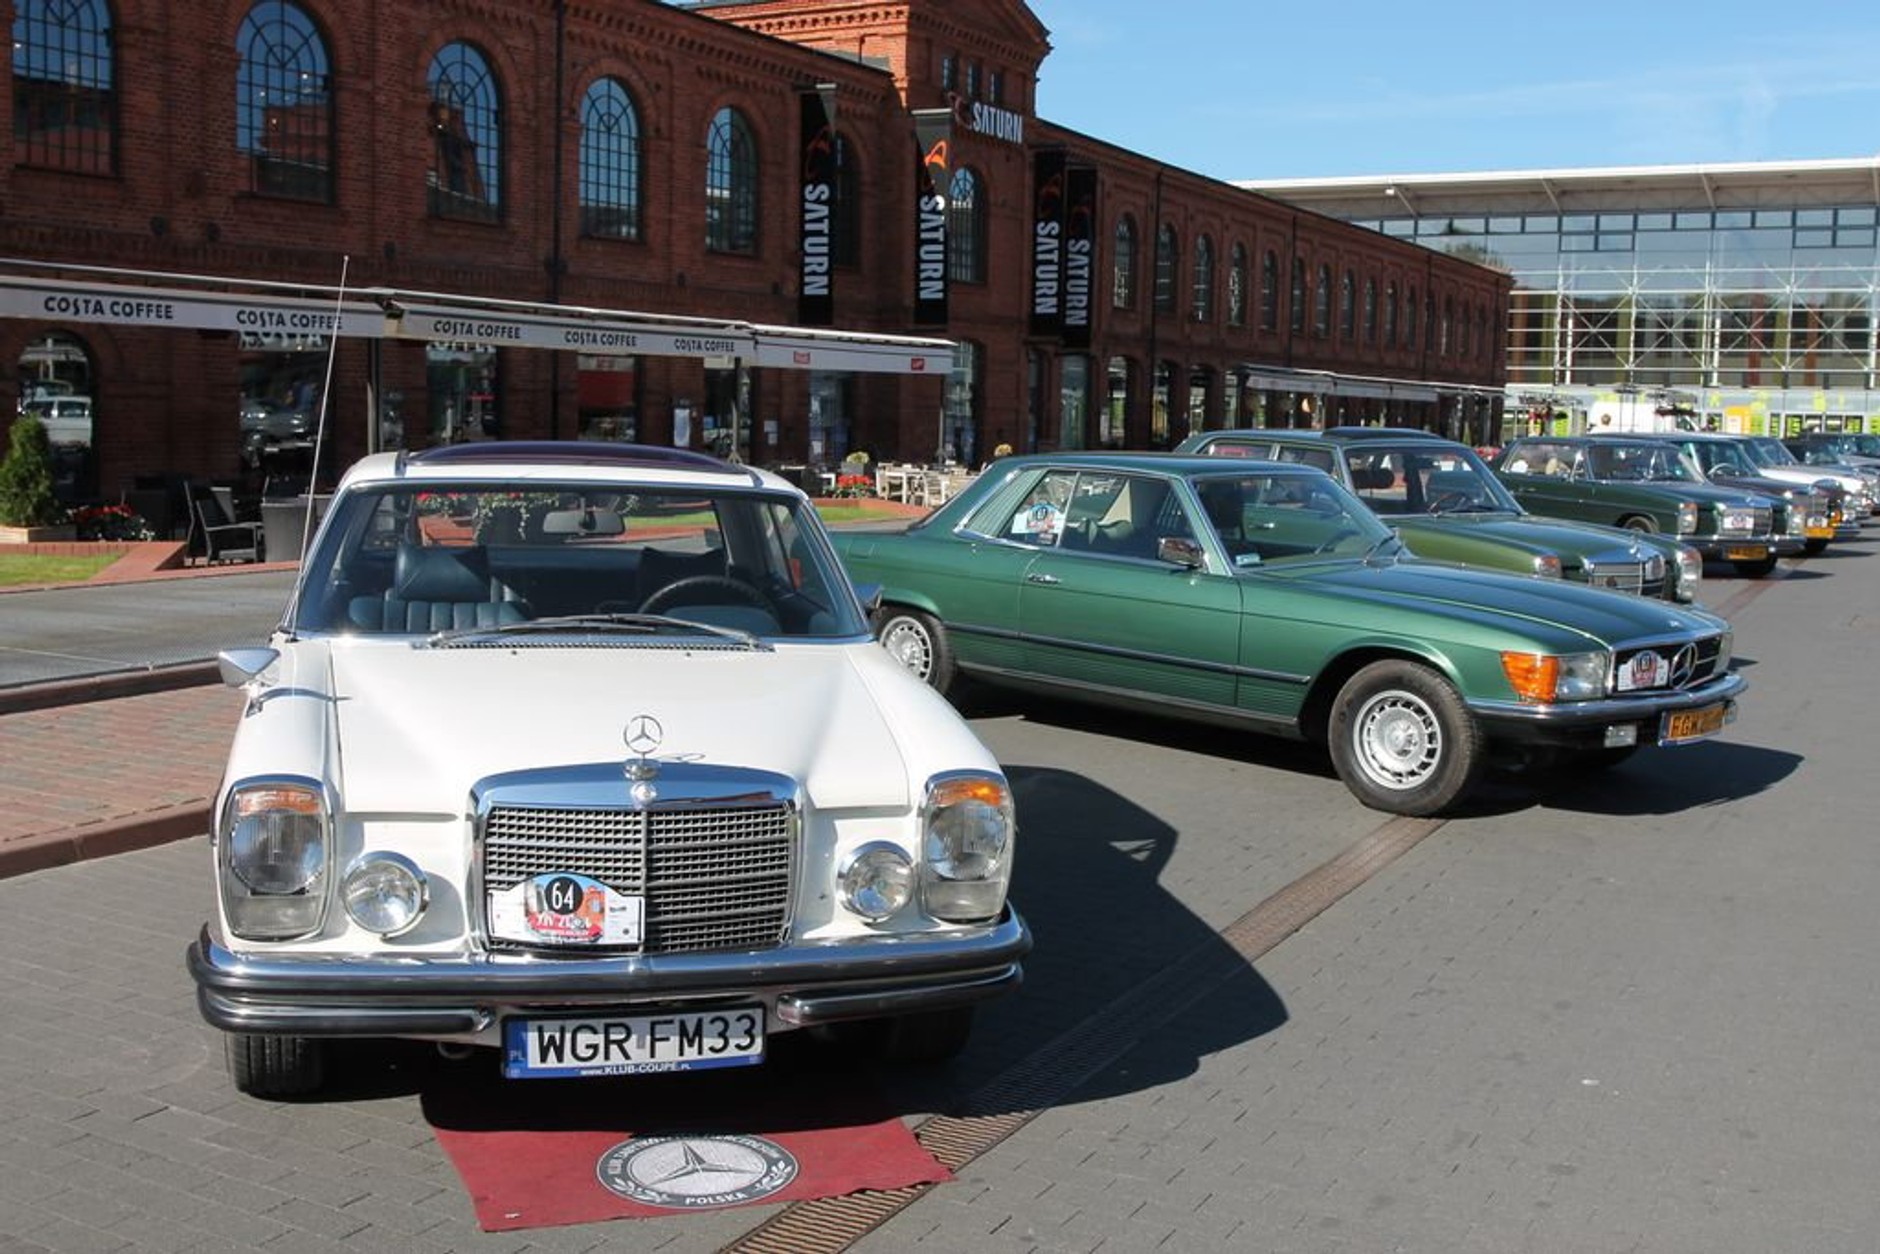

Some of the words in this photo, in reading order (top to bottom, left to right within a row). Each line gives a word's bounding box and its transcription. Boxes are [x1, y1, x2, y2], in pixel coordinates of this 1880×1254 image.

[972, 101, 1023, 144] SATURN
[803, 183, 830, 296] SATURN
[919, 195, 945, 300] SATURN
[1035, 221, 1060, 315] SATURN
[1065, 238, 1091, 326] SATURN
[44, 296, 105, 316] COSTA
[110, 302, 174, 319] COFFEE
[236, 310, 286, 328] COSTA
[290, 314, 343, 330] COFFEE
[433, 320, 473, 336] COSTA
[477, 324, 521, 339] COFFEE
[565, 331, 598, 345] COSTA
[600, 334, 637, 347] COFFEE
[674, 339, 702, 351] COSTA
[704, 340, 735, 352] COFFEE
[552, 882, 575, 909] 64
[537, 1022, 632, 1063] WGR
[650, 1014, 756, 1058] FM33
[685, 1191, 748, 1205] POLSKA
